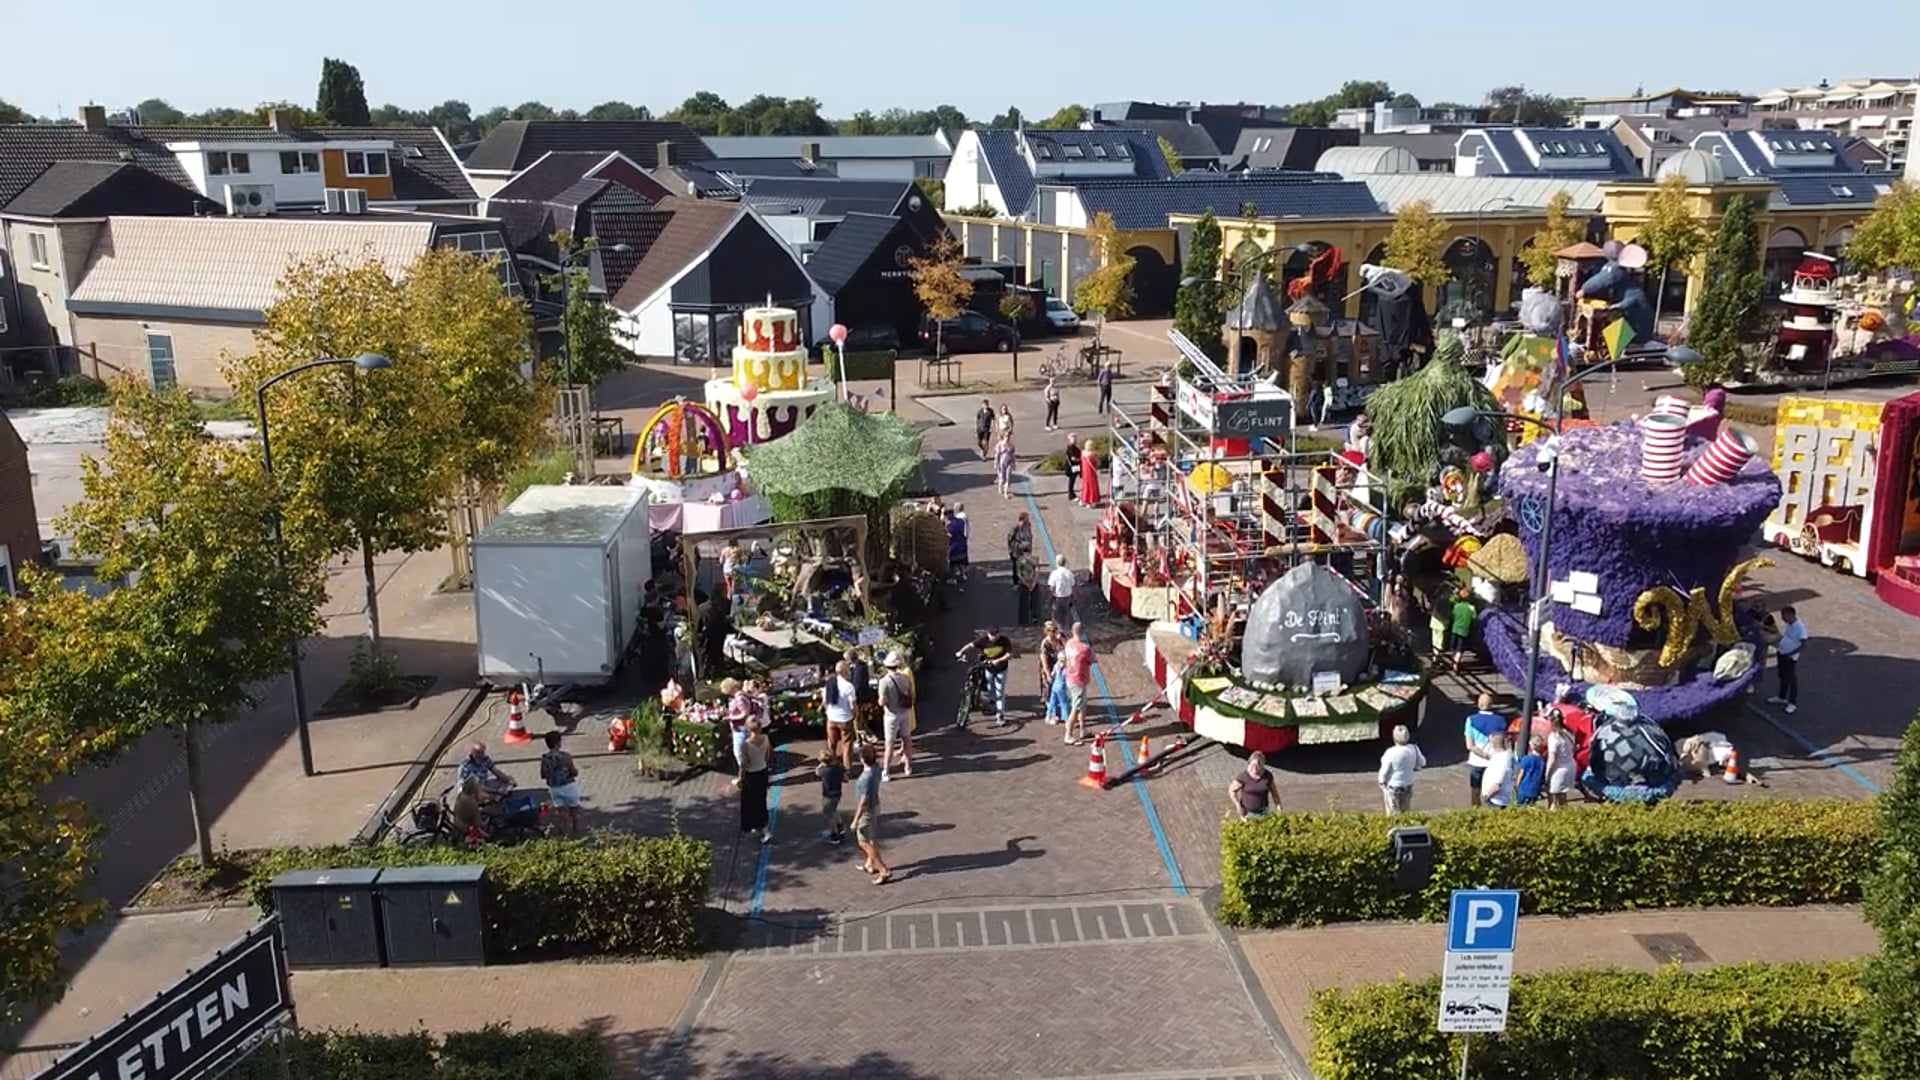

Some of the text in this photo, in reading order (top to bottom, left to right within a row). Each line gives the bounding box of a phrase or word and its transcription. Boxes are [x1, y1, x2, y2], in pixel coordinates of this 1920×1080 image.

[1251, 416, 1284, 427] FLINT
[1284, 611, 1303, 628] De
[1465, 899, 1503, 944] P
[88, 972, 251, 1080] ETTEN
